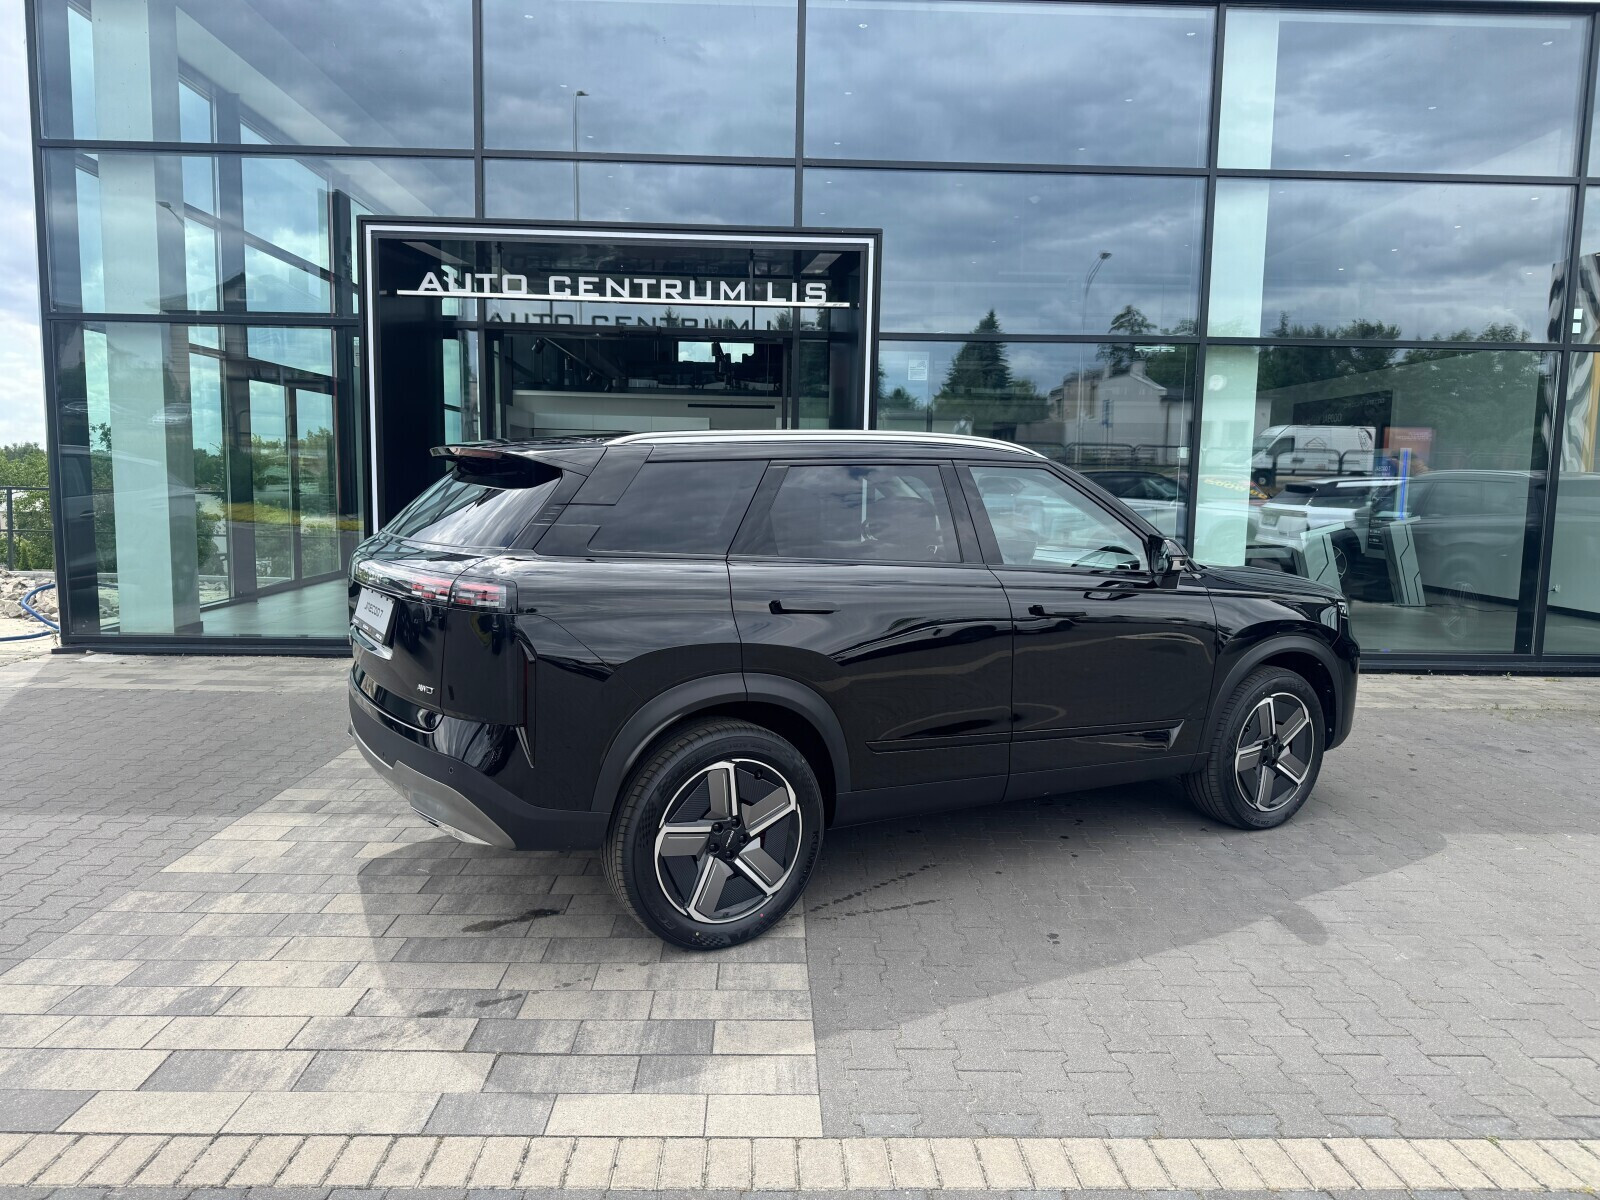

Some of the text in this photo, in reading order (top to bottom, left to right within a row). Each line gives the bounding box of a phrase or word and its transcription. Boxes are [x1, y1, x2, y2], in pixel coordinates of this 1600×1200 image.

[417, 271, 827, 303] AUTO CENTRUM LIS
[416, 683, 435, 695] AWD
